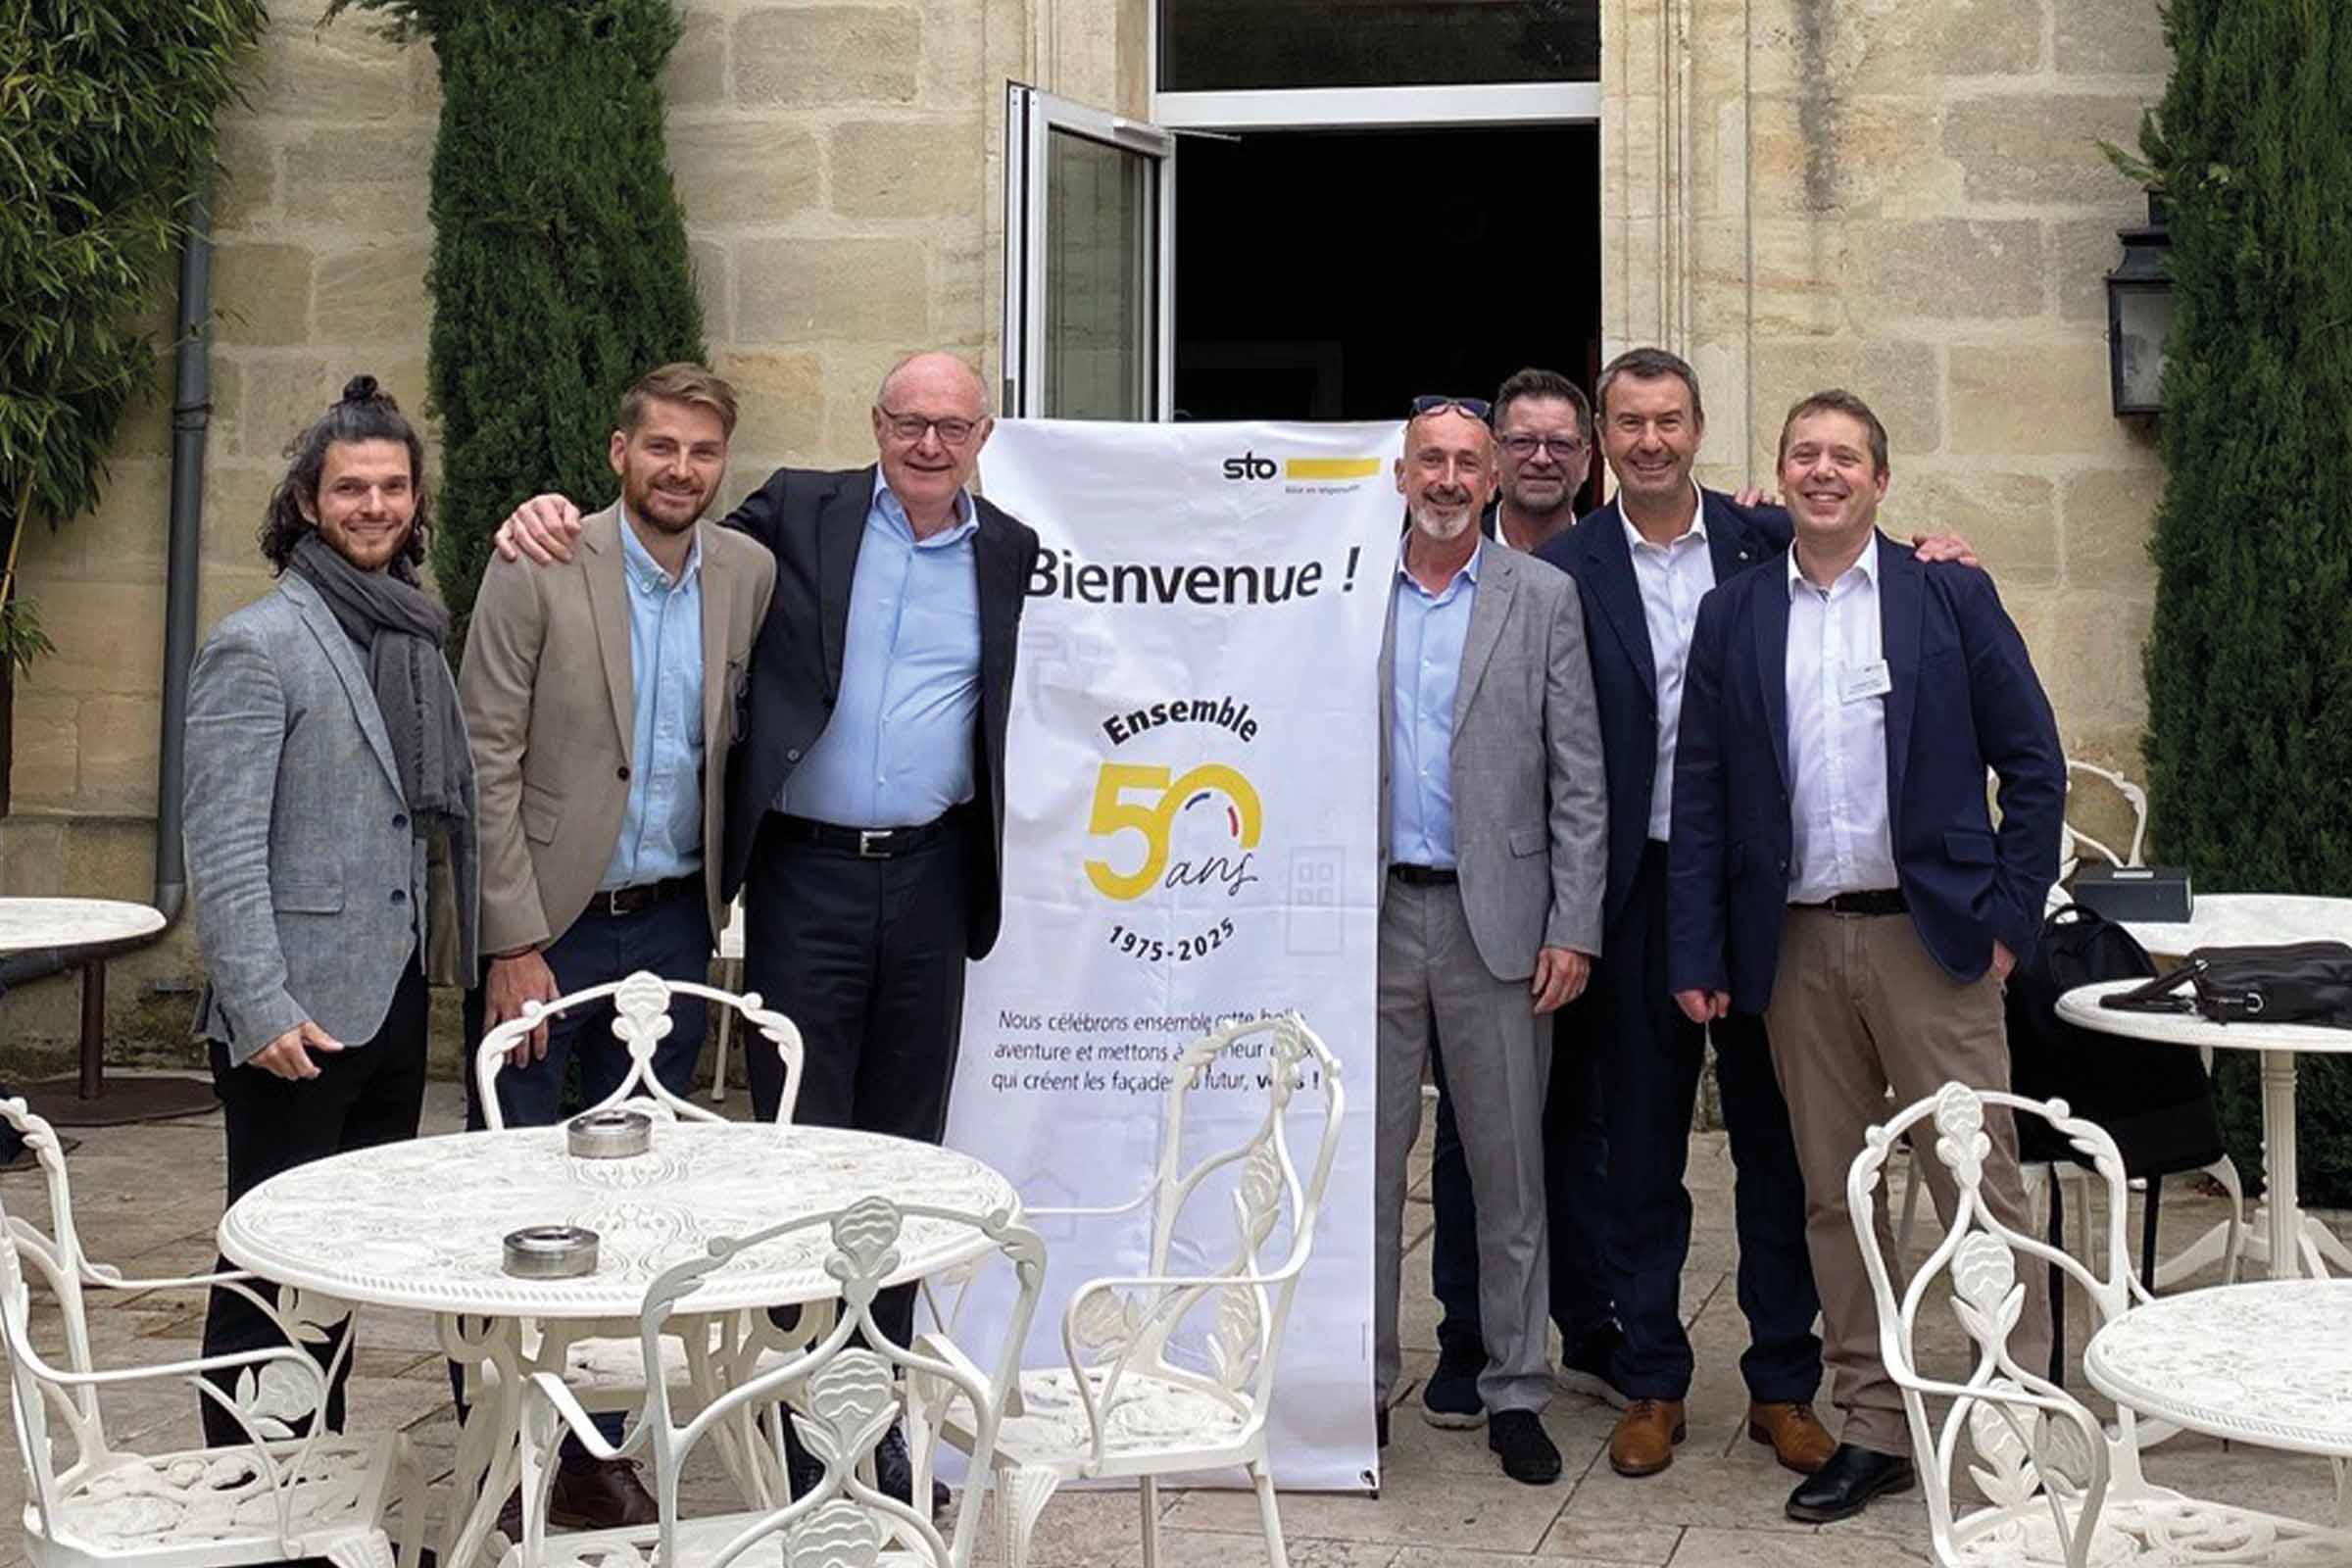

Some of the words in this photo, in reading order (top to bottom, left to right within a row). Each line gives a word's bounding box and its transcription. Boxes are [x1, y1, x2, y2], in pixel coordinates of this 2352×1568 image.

[1223, 451, 1277, 480] sto
[1025, 547, 1322, 605] Bienvenue
[1342, 546, 1361, 592] !
[1102, 696, 1258, 746] Ensemble
[1084, 762, 1263, 902] 50
[1165, 853, 1258, 897] ans
[1109, 917, 1235, 962] 1975-2025
[999, 1010, 1042, 1030] Nous
[1048, 1011, 1128, 1033] célébrons
[1134, 1011, 1212, 1032] ensemble
[994, 1043, 1071, 1060] aventure
[1076, 1045, 1093, 1060] et
[1098, 1043, 1167, 1061] mettons
[991, 1071, 1018, 1094] qui
[1023, 1070, 1080, 1091] créent
[1083, 1071, 1105, 1091] les
[1256, 1073, 1304, 1090] vs
[1312, 1070, 1319, 1090] !
